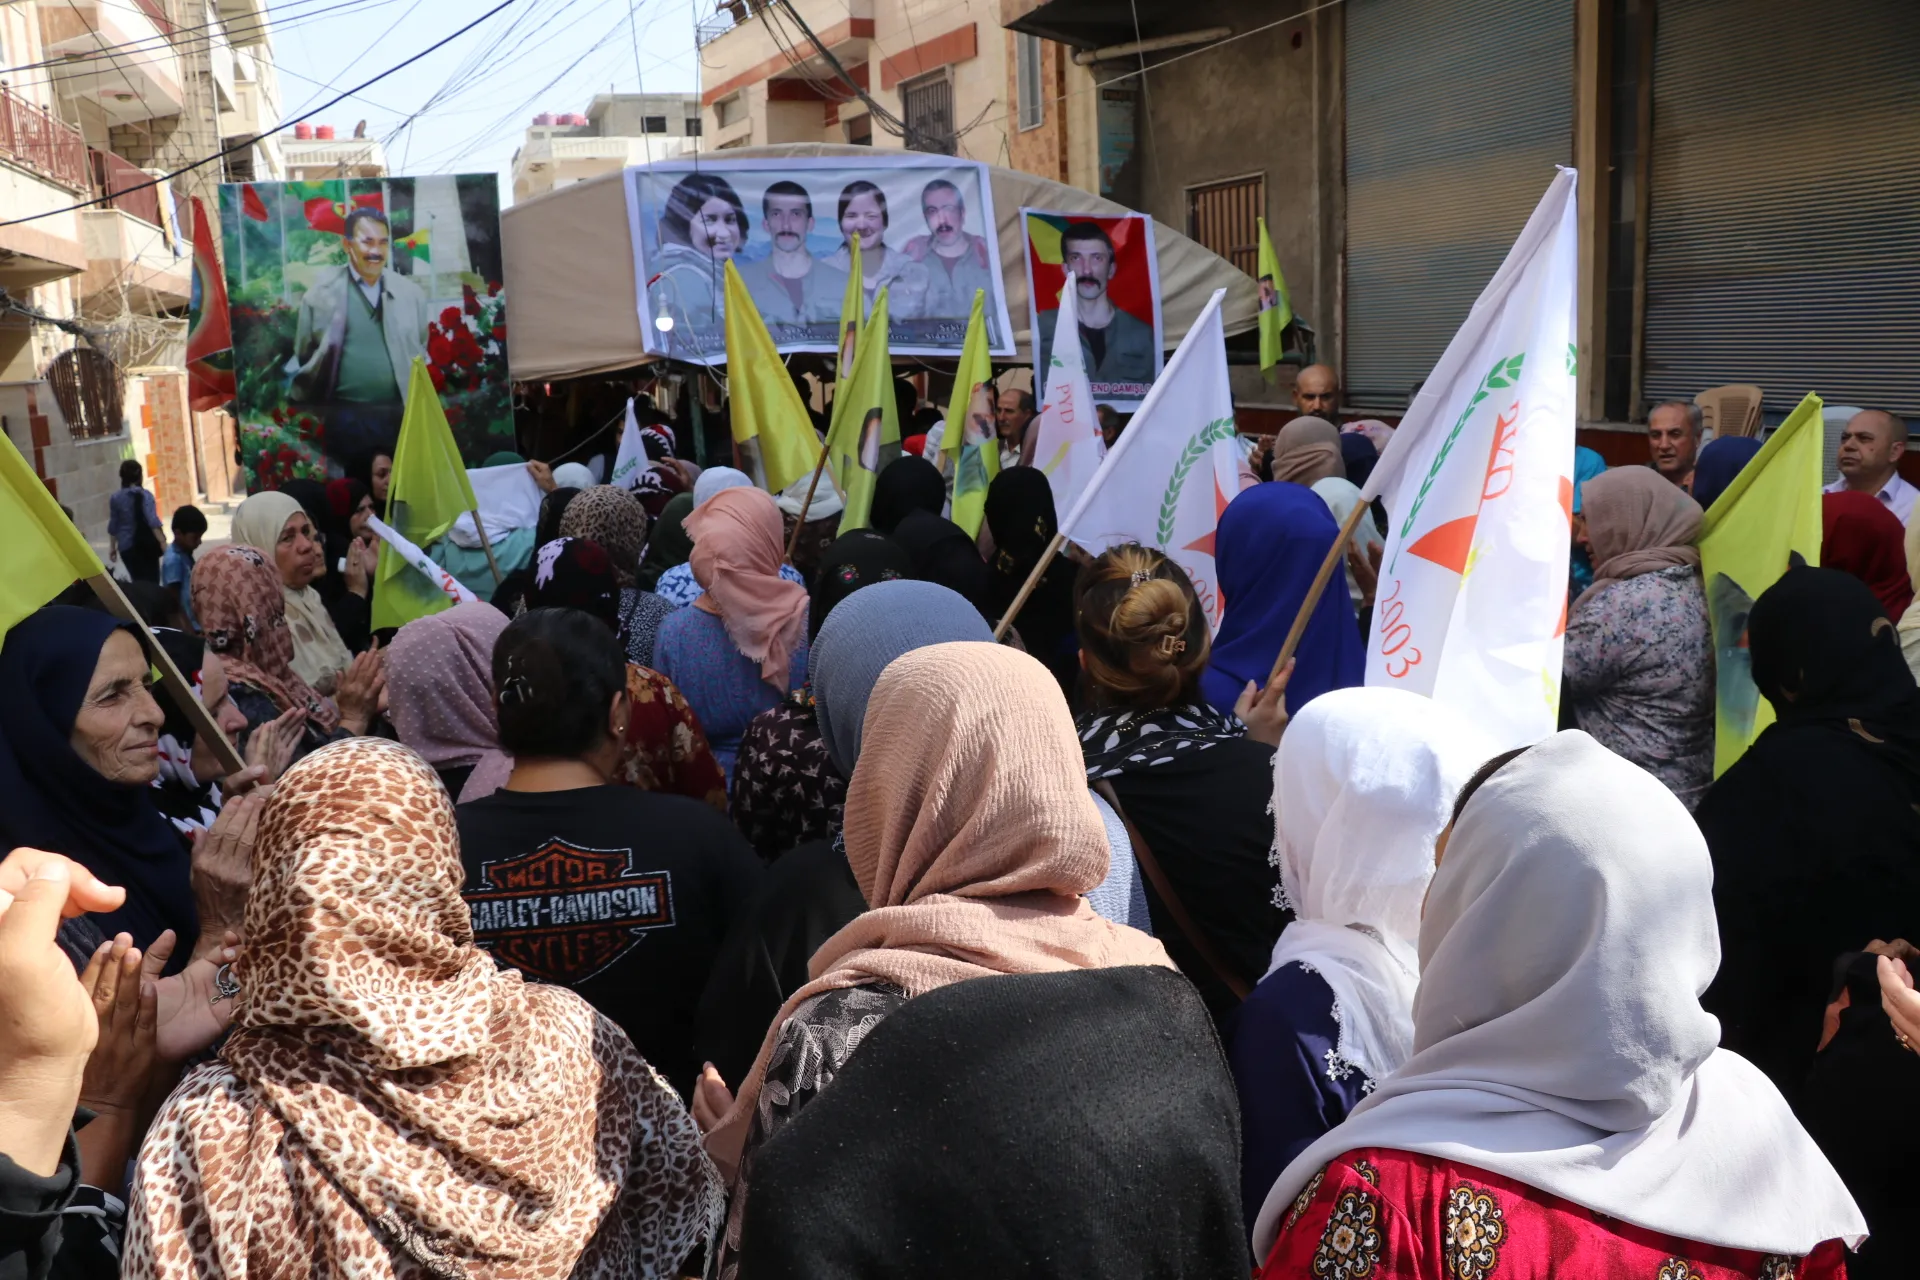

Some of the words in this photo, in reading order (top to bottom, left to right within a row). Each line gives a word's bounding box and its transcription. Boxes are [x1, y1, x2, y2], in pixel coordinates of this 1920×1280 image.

[1056, 384, 1075, 424] PYD
[1381, 580, 1422, 678] 2003
[507, 853, 607, 888] MOTOR
[471, 886, 658, 930] HARLEY-DAVIDSON
[509, 931, 610, 971] CYCLES
